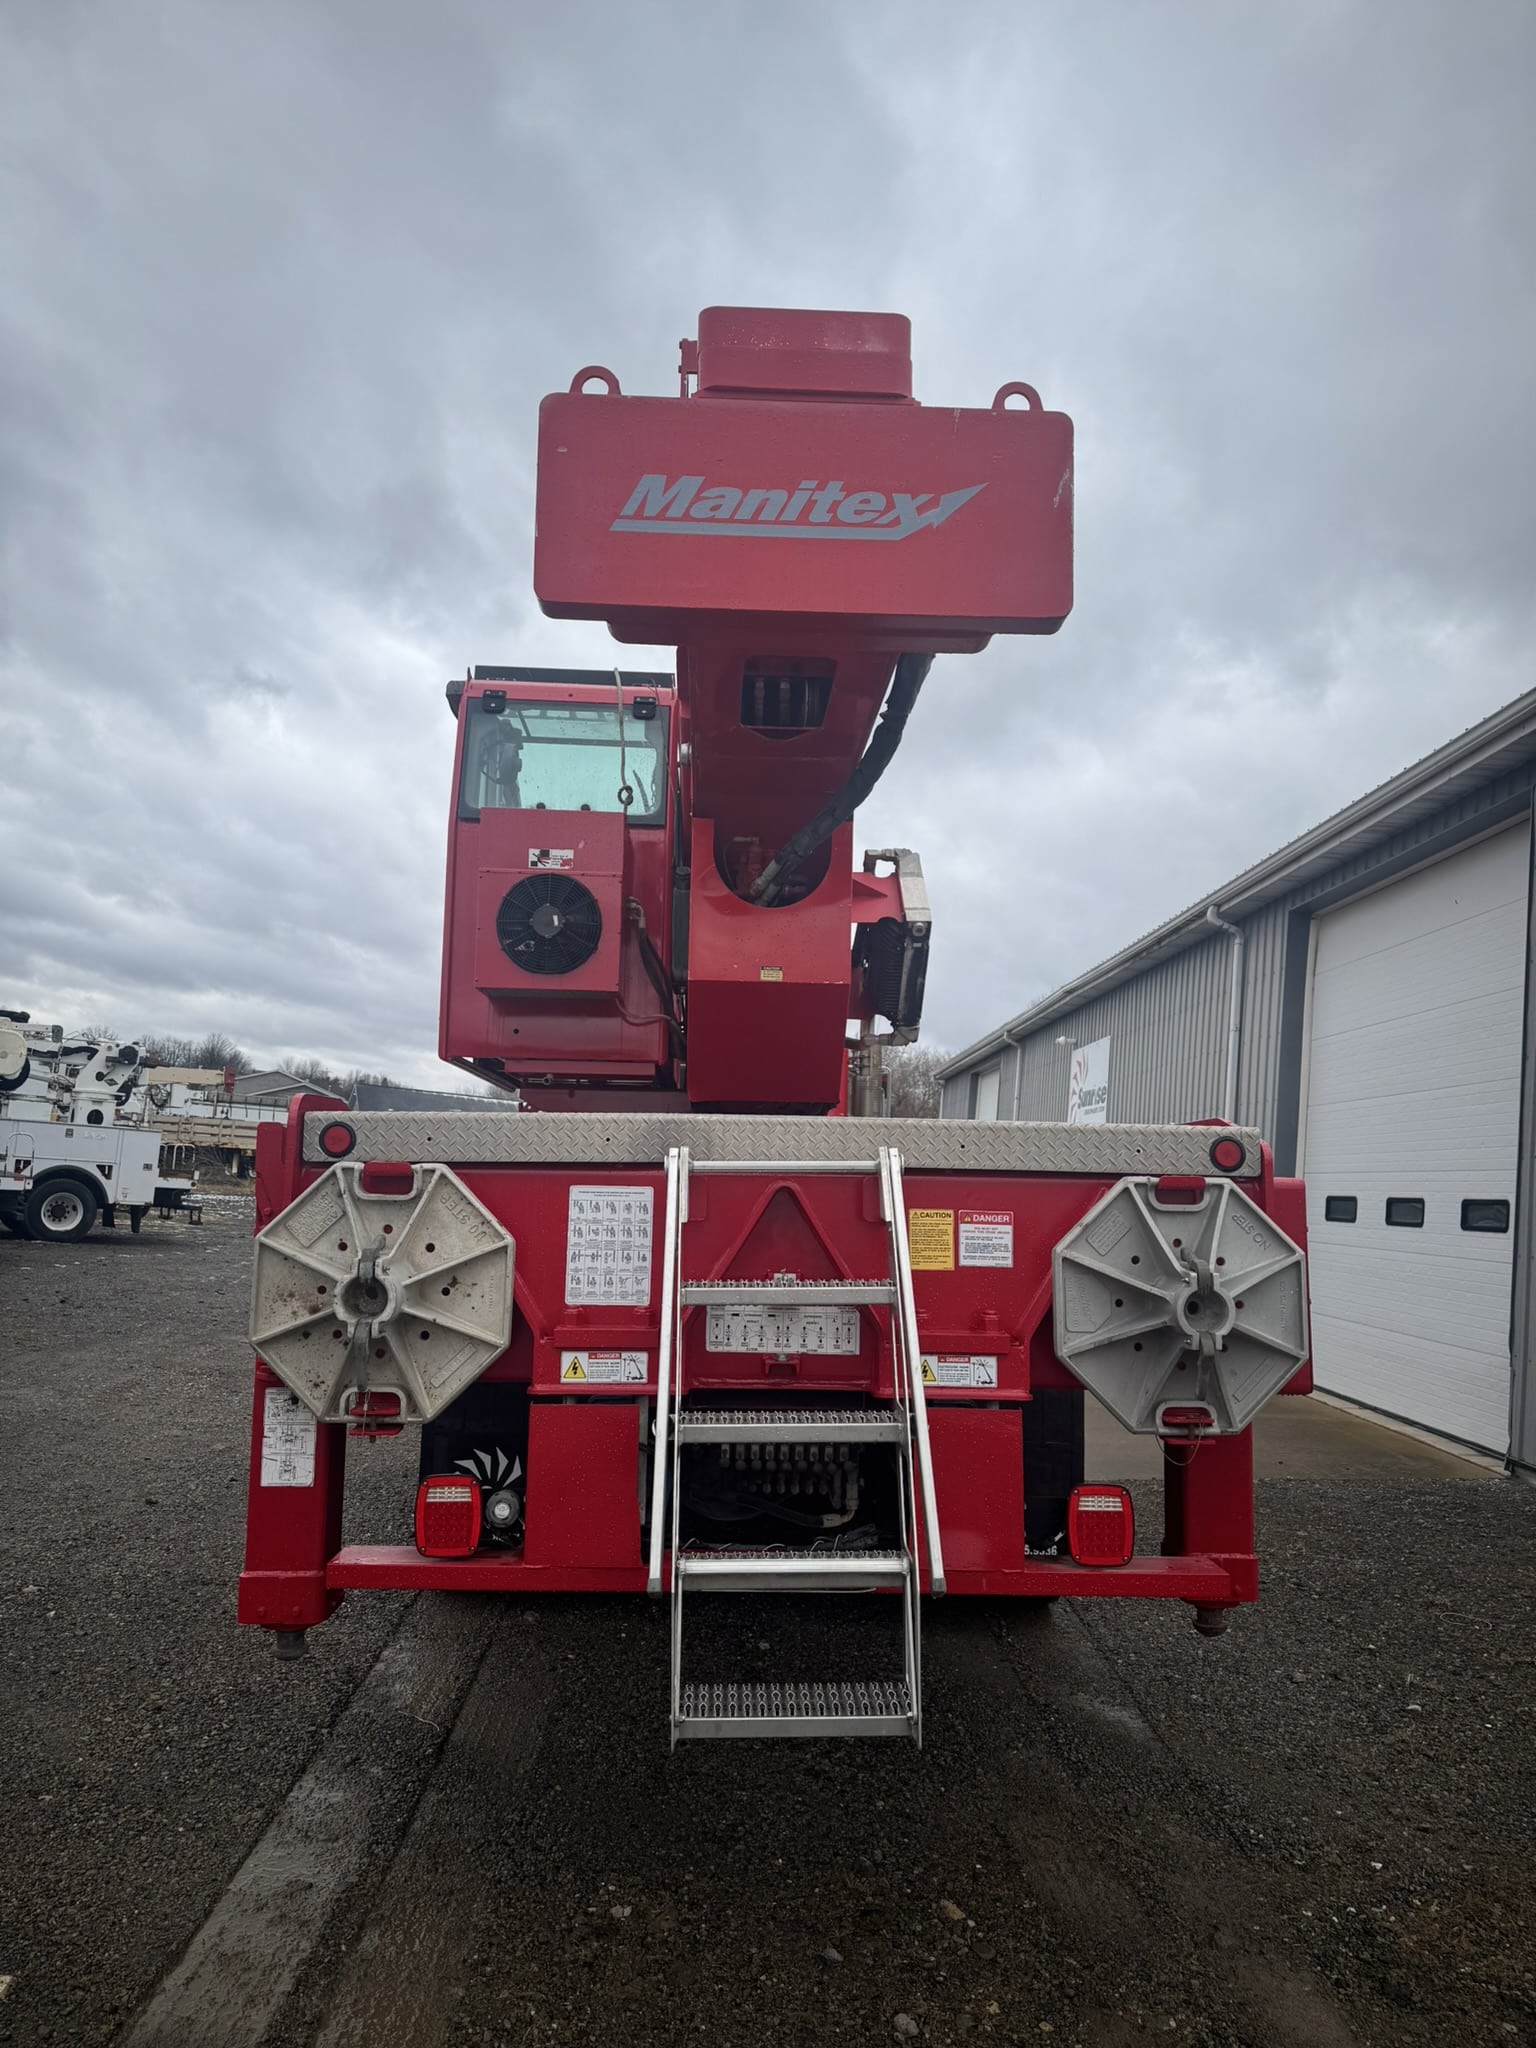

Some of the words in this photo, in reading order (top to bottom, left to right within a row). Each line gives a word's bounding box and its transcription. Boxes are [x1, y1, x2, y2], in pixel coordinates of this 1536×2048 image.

[616, 473, 989, 536] Manitex
[919, 1211, 952, 1219] CAUTION
[973, 1214, 1010, 1223] DANGER
[1232, 1214, 1255, 1234] STEP
[1253, 1232, 1272, 1250] NO
